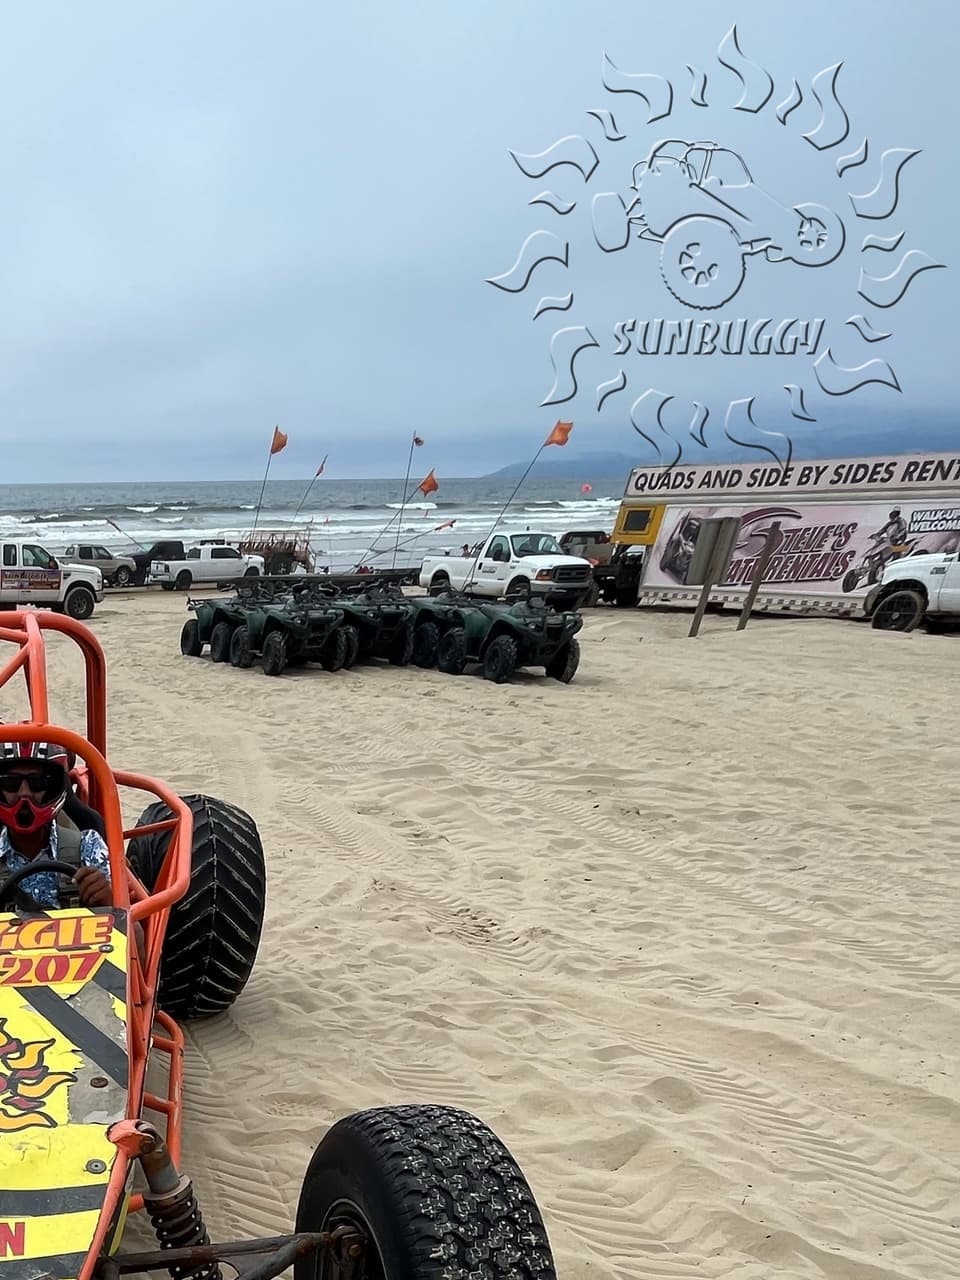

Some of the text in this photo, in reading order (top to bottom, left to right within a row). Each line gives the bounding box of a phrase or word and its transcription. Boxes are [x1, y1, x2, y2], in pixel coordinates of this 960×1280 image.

[634, 471, 696, 492] QUADS
[698, 469, 743, 489] AND
[746, 466, 794, 488] SIDE
[797, 465, 829, 486] BY
[829, 461, 897, 485] SIDES
[763, 550, 857, 582] RENTALS
